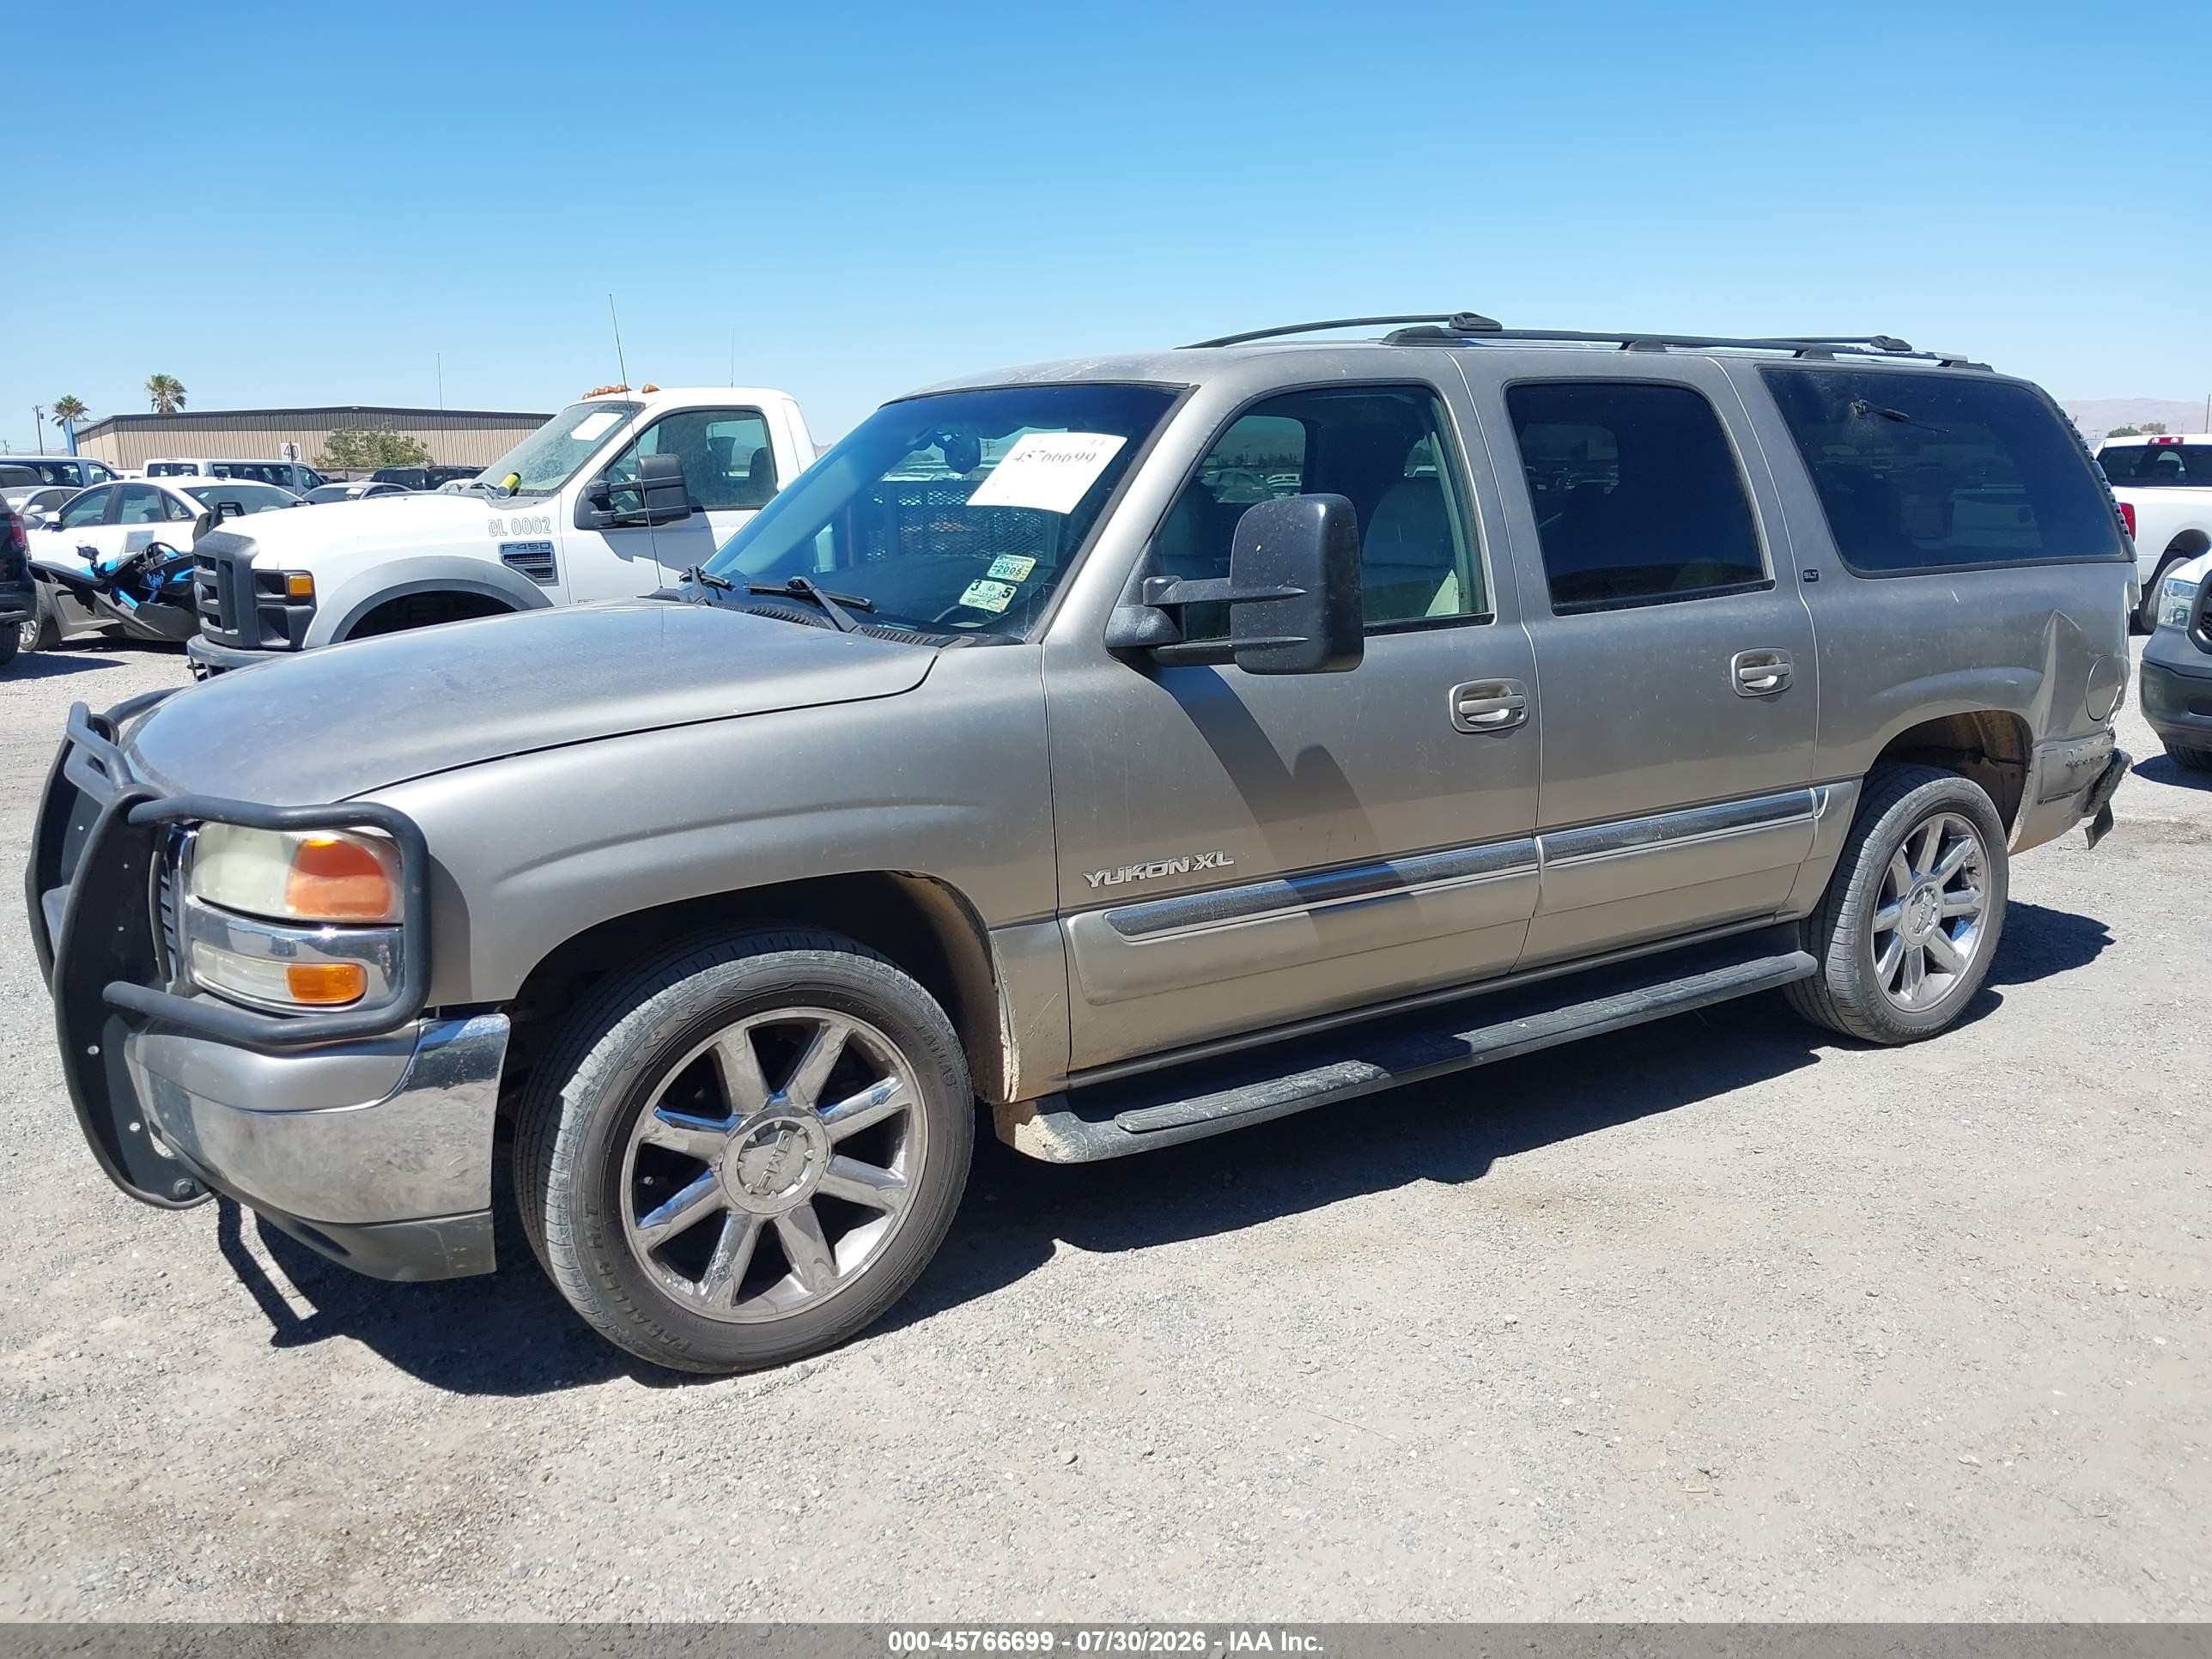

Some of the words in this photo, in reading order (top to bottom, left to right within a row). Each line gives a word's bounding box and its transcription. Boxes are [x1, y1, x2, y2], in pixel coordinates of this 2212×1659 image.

[283, 445, 299, 459] 40
[511, 516, 552, 536] 0002
[502, 542, 551, 551] F-450
[970, 580, 981, 592] 3
[1001, 586, 1013, 599] 5
[1082, 856, 1190, 889] YUKON
[1192, 851, 1235, 872] XL
